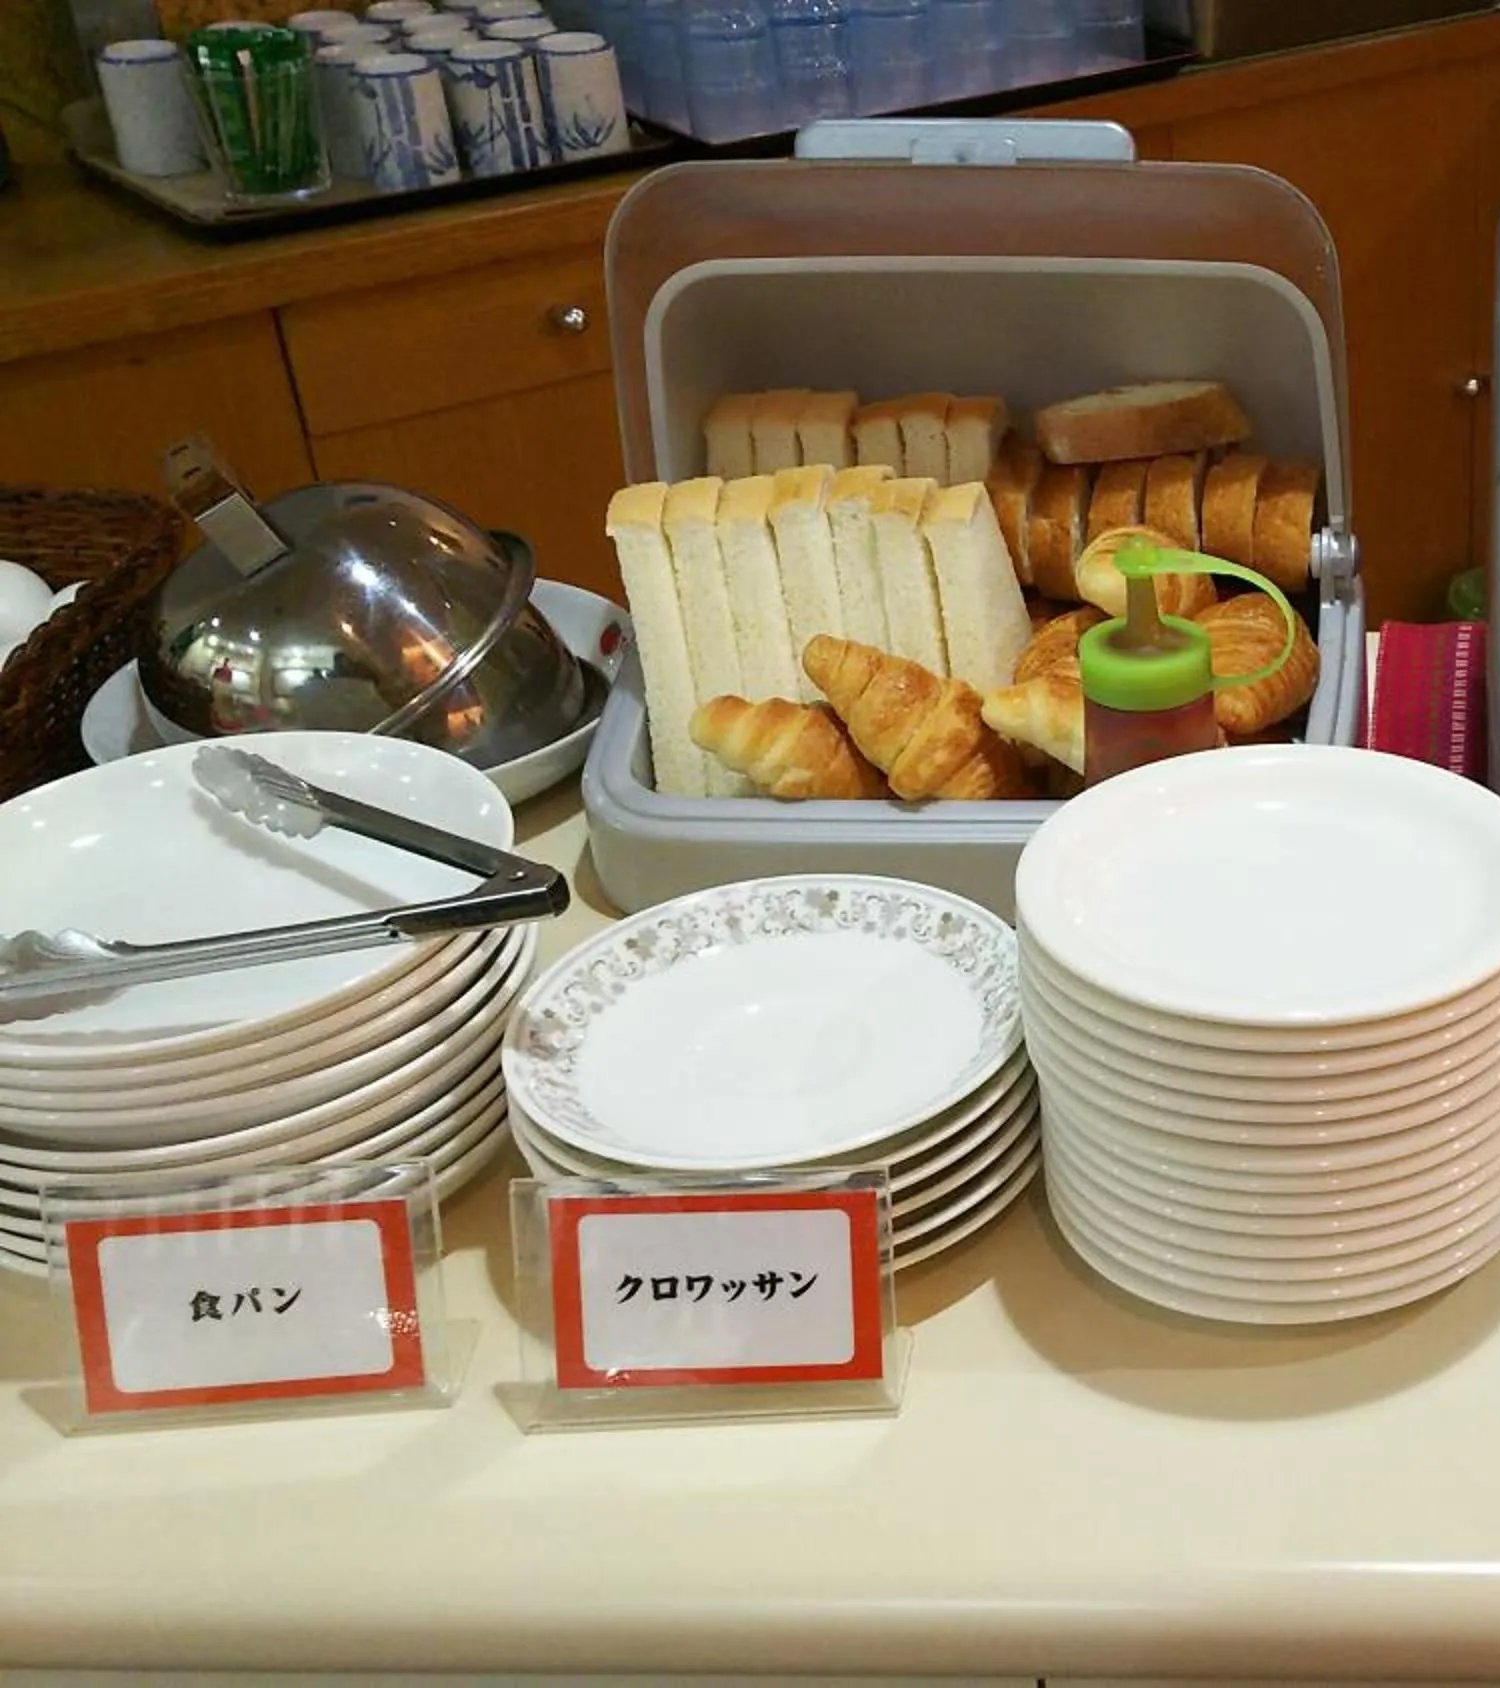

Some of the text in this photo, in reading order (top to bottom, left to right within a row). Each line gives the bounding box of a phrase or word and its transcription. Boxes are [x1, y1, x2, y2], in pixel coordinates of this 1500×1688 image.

[615, 1270, 819, 1304] クロワッサン
[189, 1287, 303, 1322] 食パン
